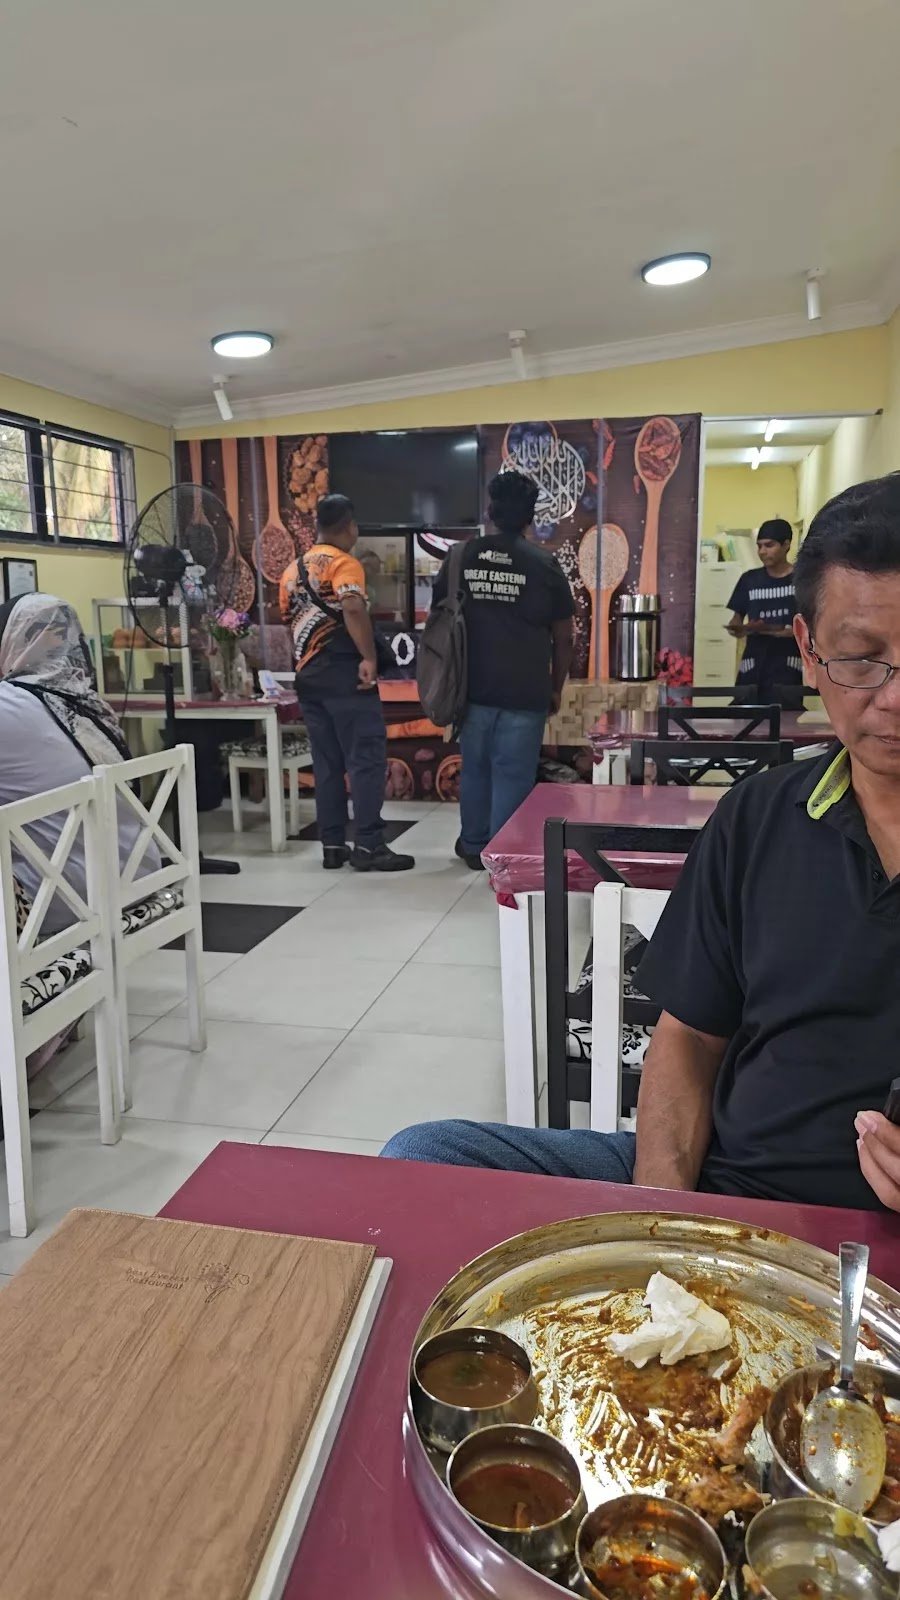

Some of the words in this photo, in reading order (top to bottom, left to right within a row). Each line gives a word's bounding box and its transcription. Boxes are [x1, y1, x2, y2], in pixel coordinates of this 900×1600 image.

[463, 569, 488, 580] GREAT
[489, 570, 526, 585] EASTERN
[468, 581, 491, 593] VIPER
[492, 583, 520, 596] ARENA
